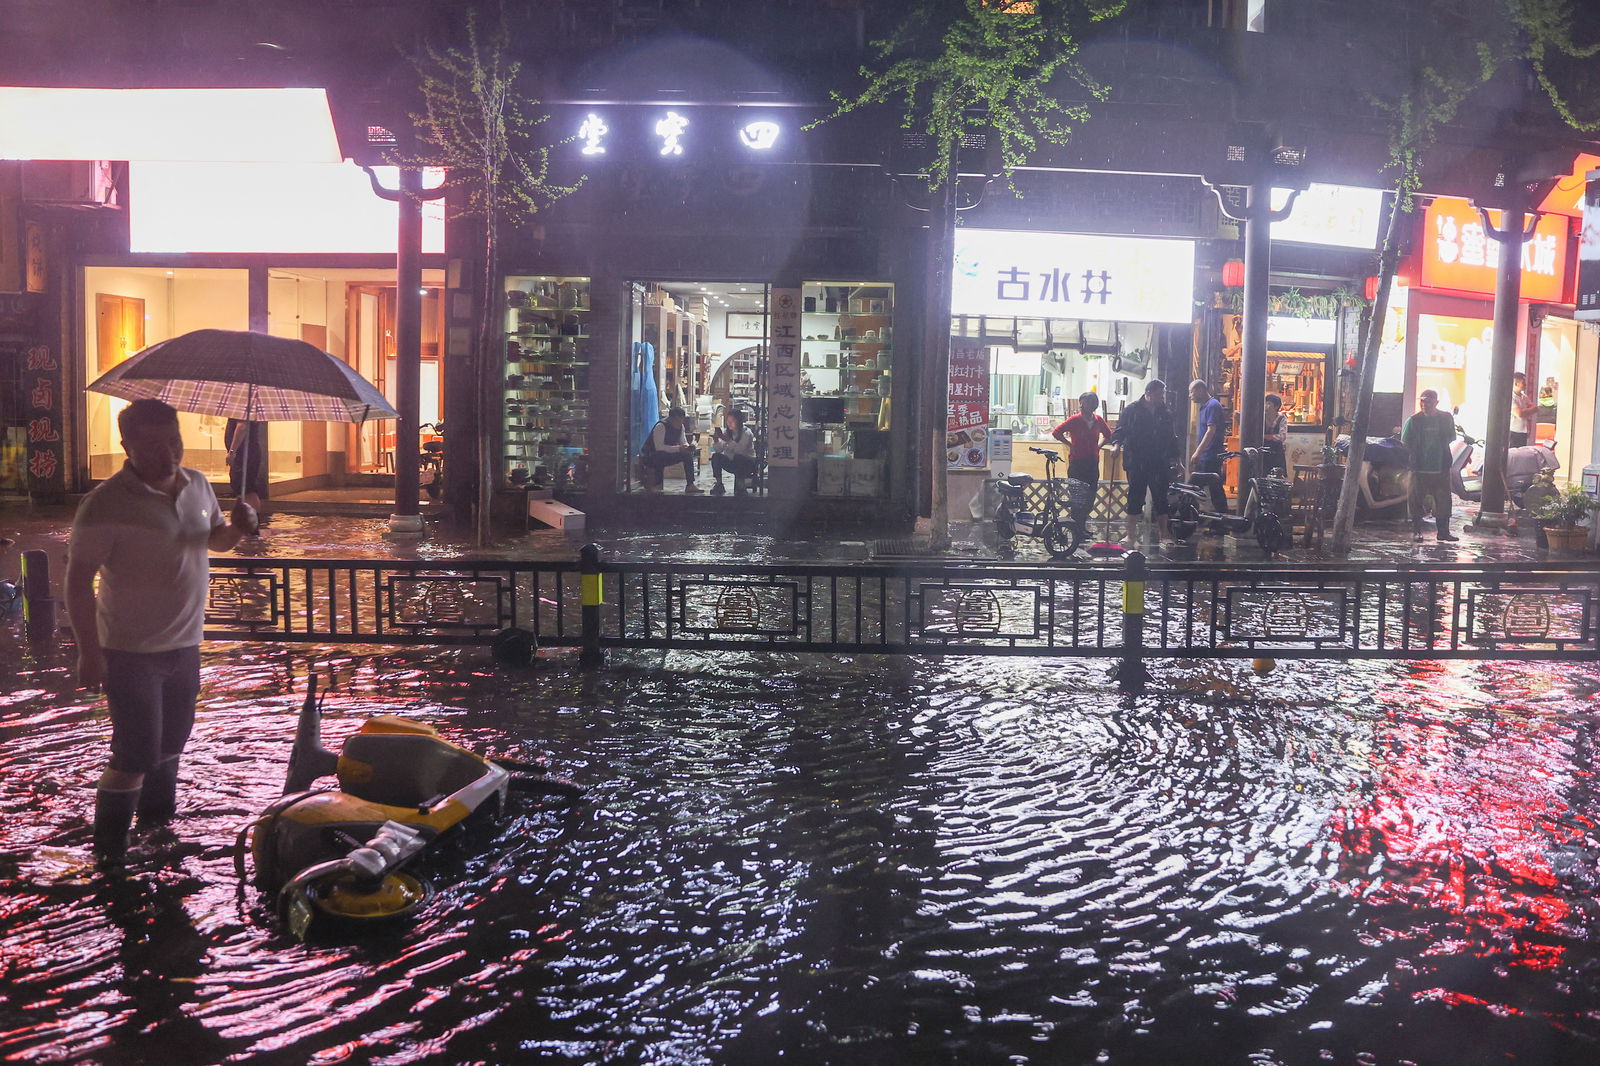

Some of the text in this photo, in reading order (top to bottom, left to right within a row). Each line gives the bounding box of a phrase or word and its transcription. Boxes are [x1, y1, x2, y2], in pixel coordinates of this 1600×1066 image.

[997, 266, 1112, 305] 古水井
[27, 344, 59, 478] 现卤现捞
[773, 325, 797, 460] 江西区域总代理
